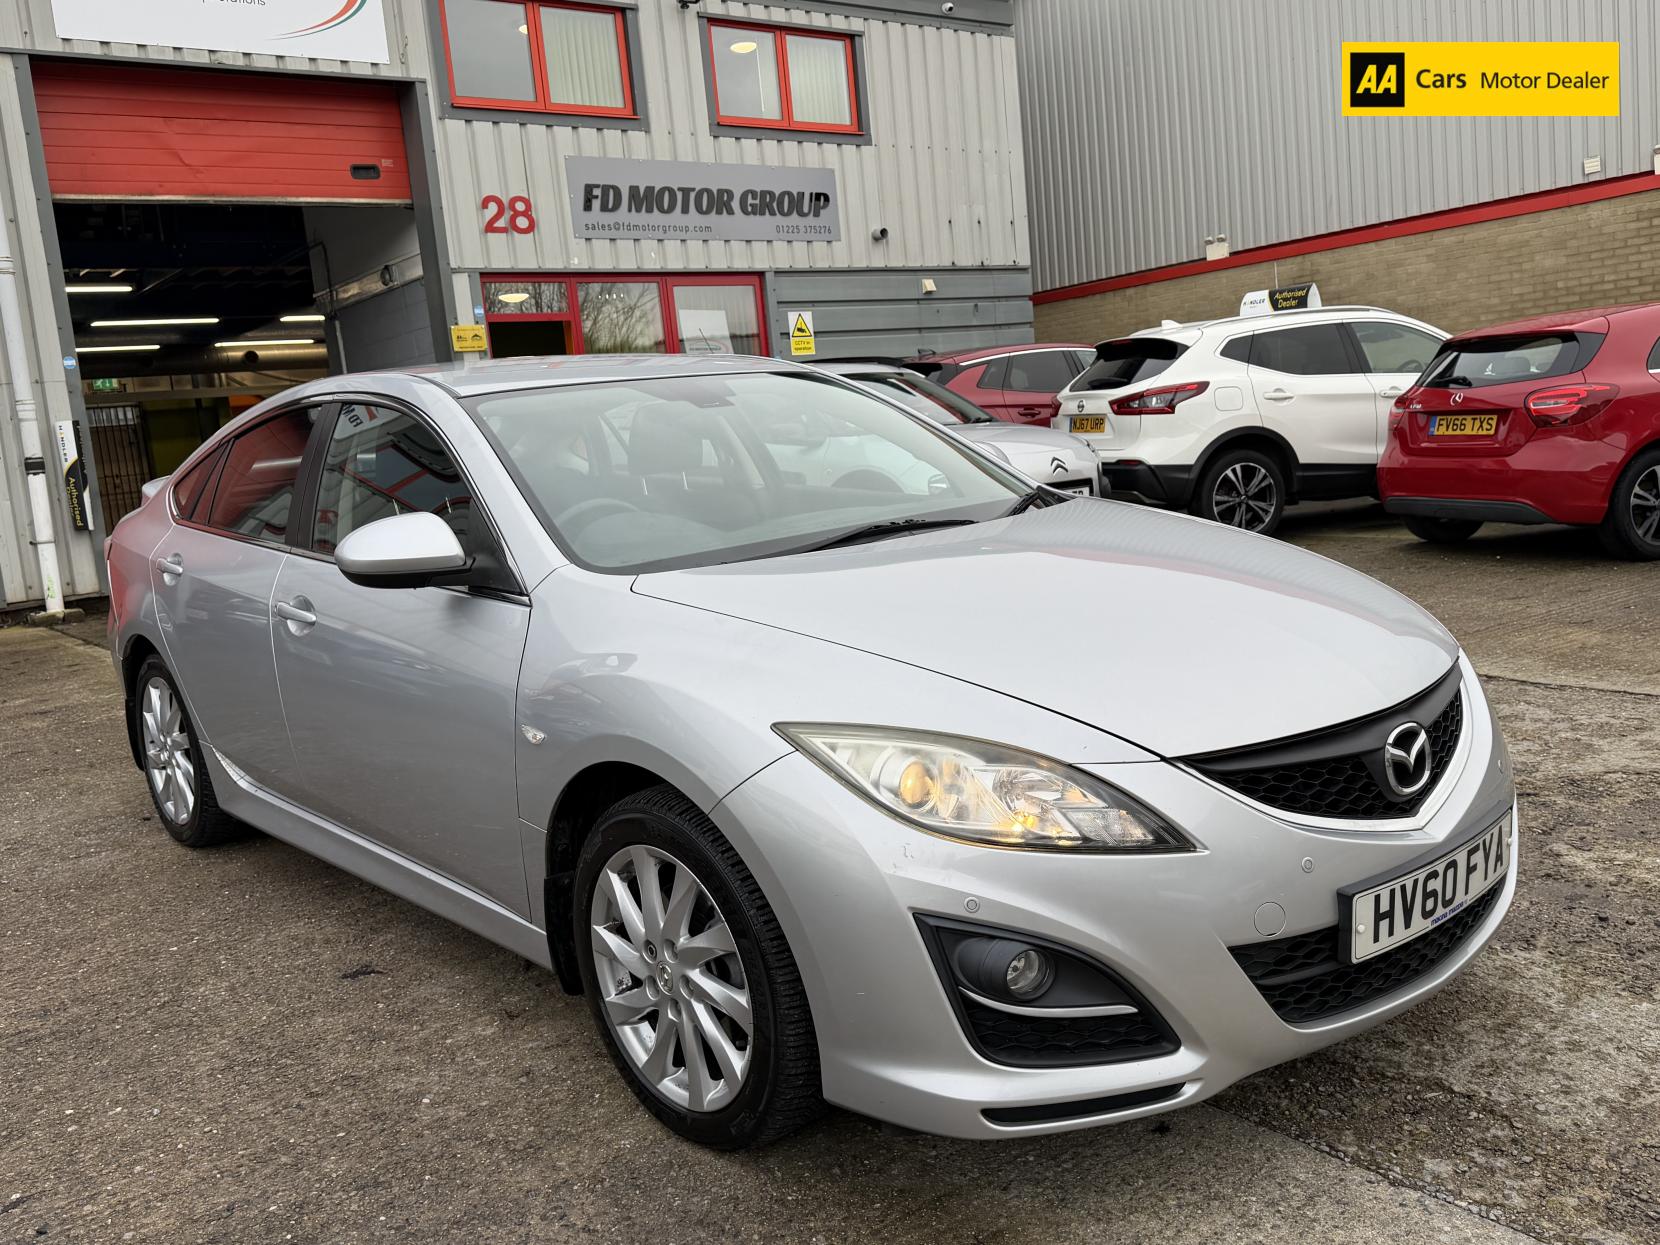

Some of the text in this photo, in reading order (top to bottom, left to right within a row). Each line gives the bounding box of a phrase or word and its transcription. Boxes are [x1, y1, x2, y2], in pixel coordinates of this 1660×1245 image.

[582, 183, 830, 218] FD MOTOR GROUP
[481, 195, 536, 235] 28
[584, 221, 832, 235] sales@fdmotorgroup.com 01225 375276
[1274, 288, 1307, 300] Authorised
[1277, 299, 1299, 308] Dealer
[1073, 418, 1104, 430] NJ67 URP
[1436, 417, 1494, 432] FV66 TXS
[69, 477, 84, 527] Authorised
[1372, 824, 1504, 945] HV60 FYA
